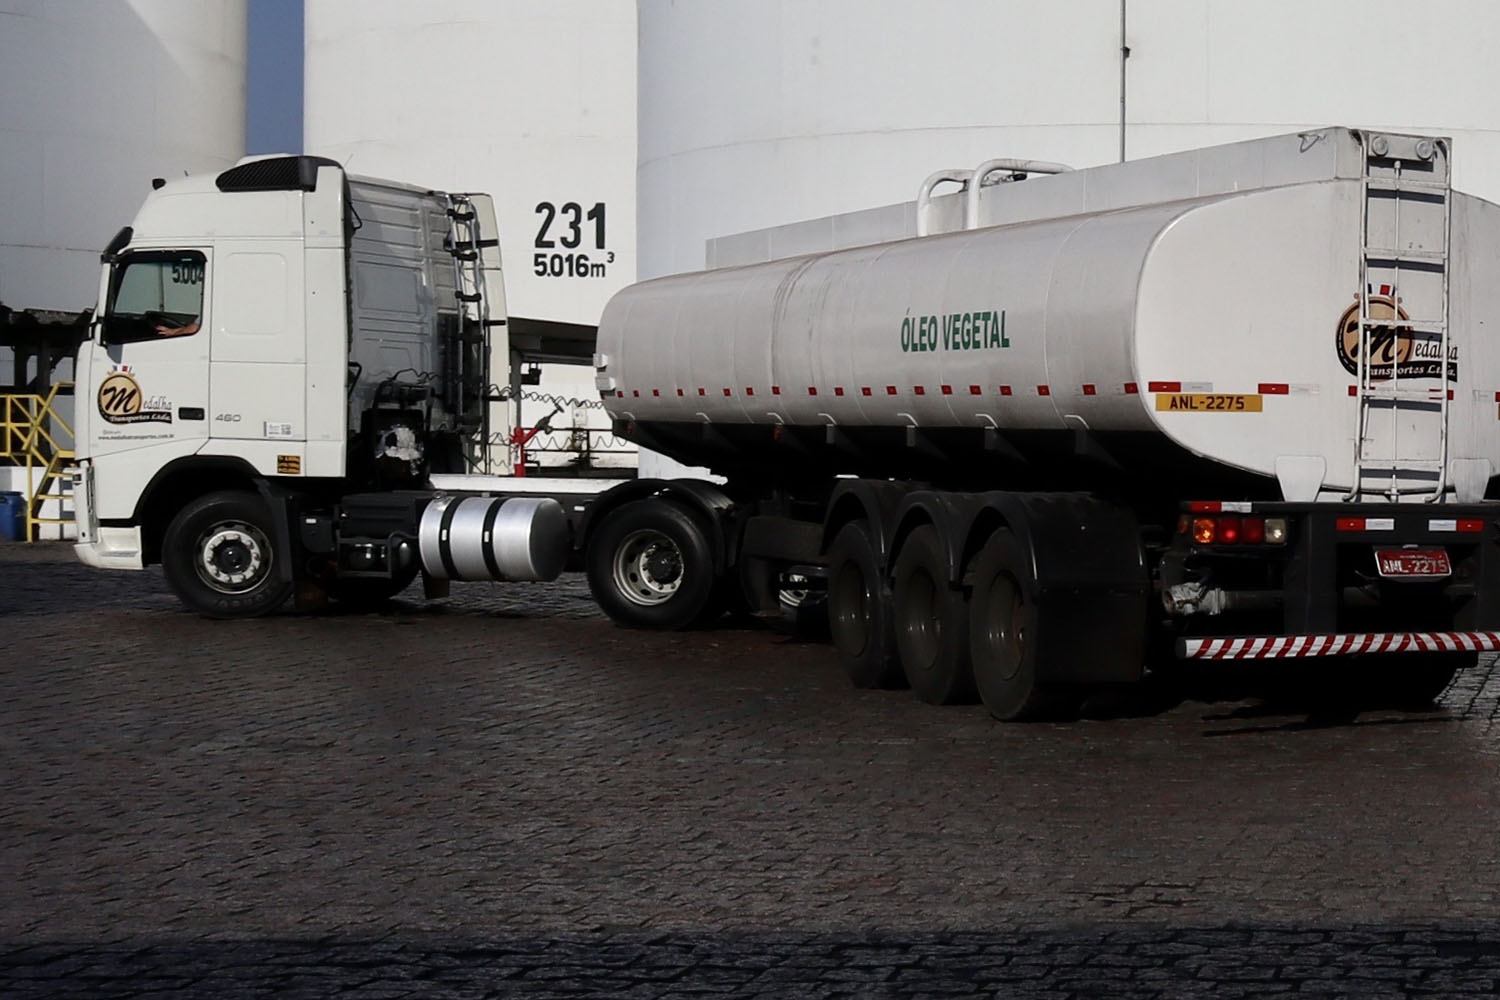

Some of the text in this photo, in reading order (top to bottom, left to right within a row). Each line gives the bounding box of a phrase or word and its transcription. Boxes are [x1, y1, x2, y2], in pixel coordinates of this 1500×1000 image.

[534, 201, 606, 250] 231
[900, 306, 1010, 352] ÓLEO VEGETAL
[1169, 395, 1245, 410] ANL-2275
[215, 413, 242, 422] 460
[1382, 559, 1449, 574] ANL-2275
